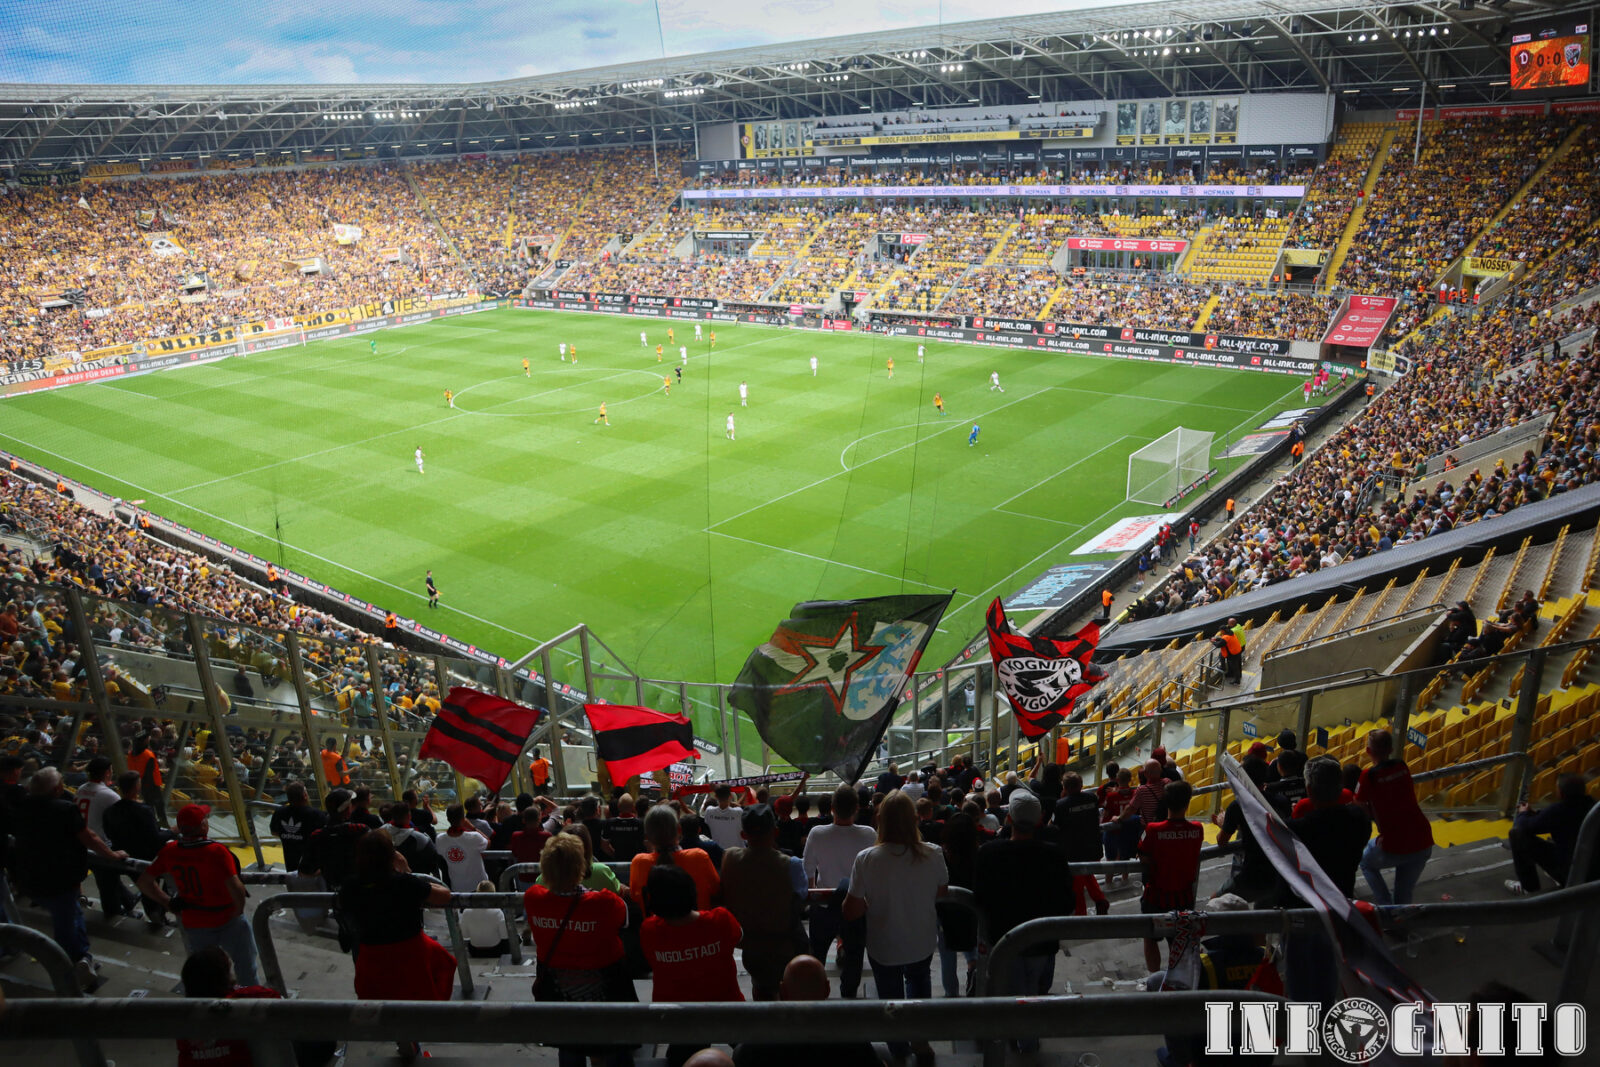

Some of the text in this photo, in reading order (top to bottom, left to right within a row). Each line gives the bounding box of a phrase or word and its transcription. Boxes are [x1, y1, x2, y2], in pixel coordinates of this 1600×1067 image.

[1480, 258, 1511, 271] NOSSEN
[926, 328, 964, 339] ALL-INKL.COM
[986, 334, 1024, 344] ALL-INKL.COM
[1136, 332, 1189, 344] ALL-INKL.COM
[1048, 340, 1090, 350] ALL-INKL.COM
[1114, 346, 1160, 356] ALL-INKL.COM
[1186, 351, 1234, 362] ALL-INKL.COM
[1263, 358, 1314, 370] ALL-INKL.COM
[1408, 728, 1426, 746] SVW
[280, 832, 304, 842] adidas
[1157, 829, 1200, 841] INGOLSTADT
[532, 915, 598, 933] INGOLTADT
[655, 941, 722, 964] INGOLSTADT
